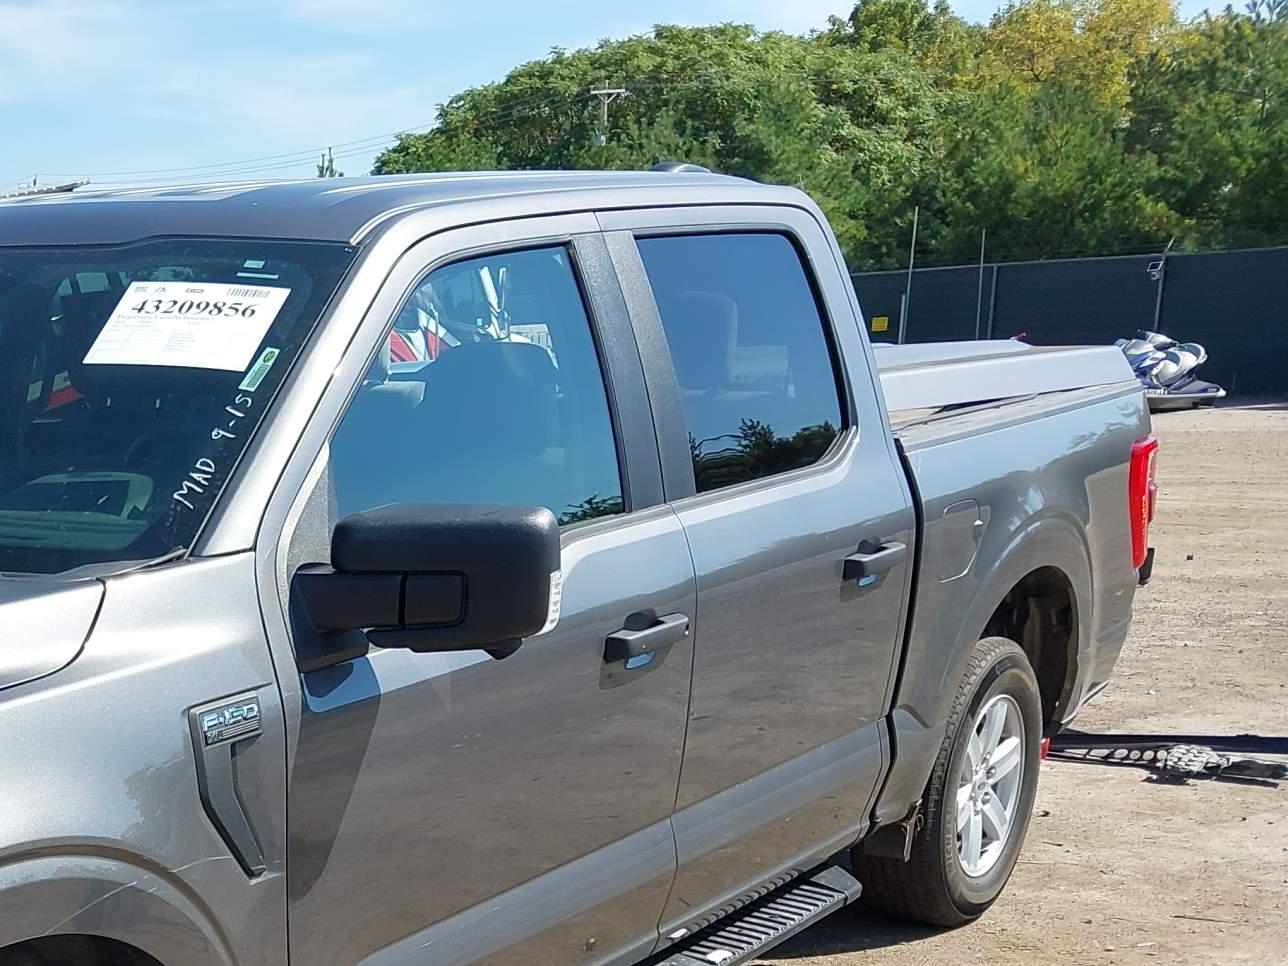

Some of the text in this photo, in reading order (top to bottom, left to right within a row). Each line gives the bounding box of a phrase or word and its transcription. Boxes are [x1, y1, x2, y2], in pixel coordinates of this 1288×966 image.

[131, 299, 259, 319] 43209856
[173, 392, 253, 510] MAD 9-15
